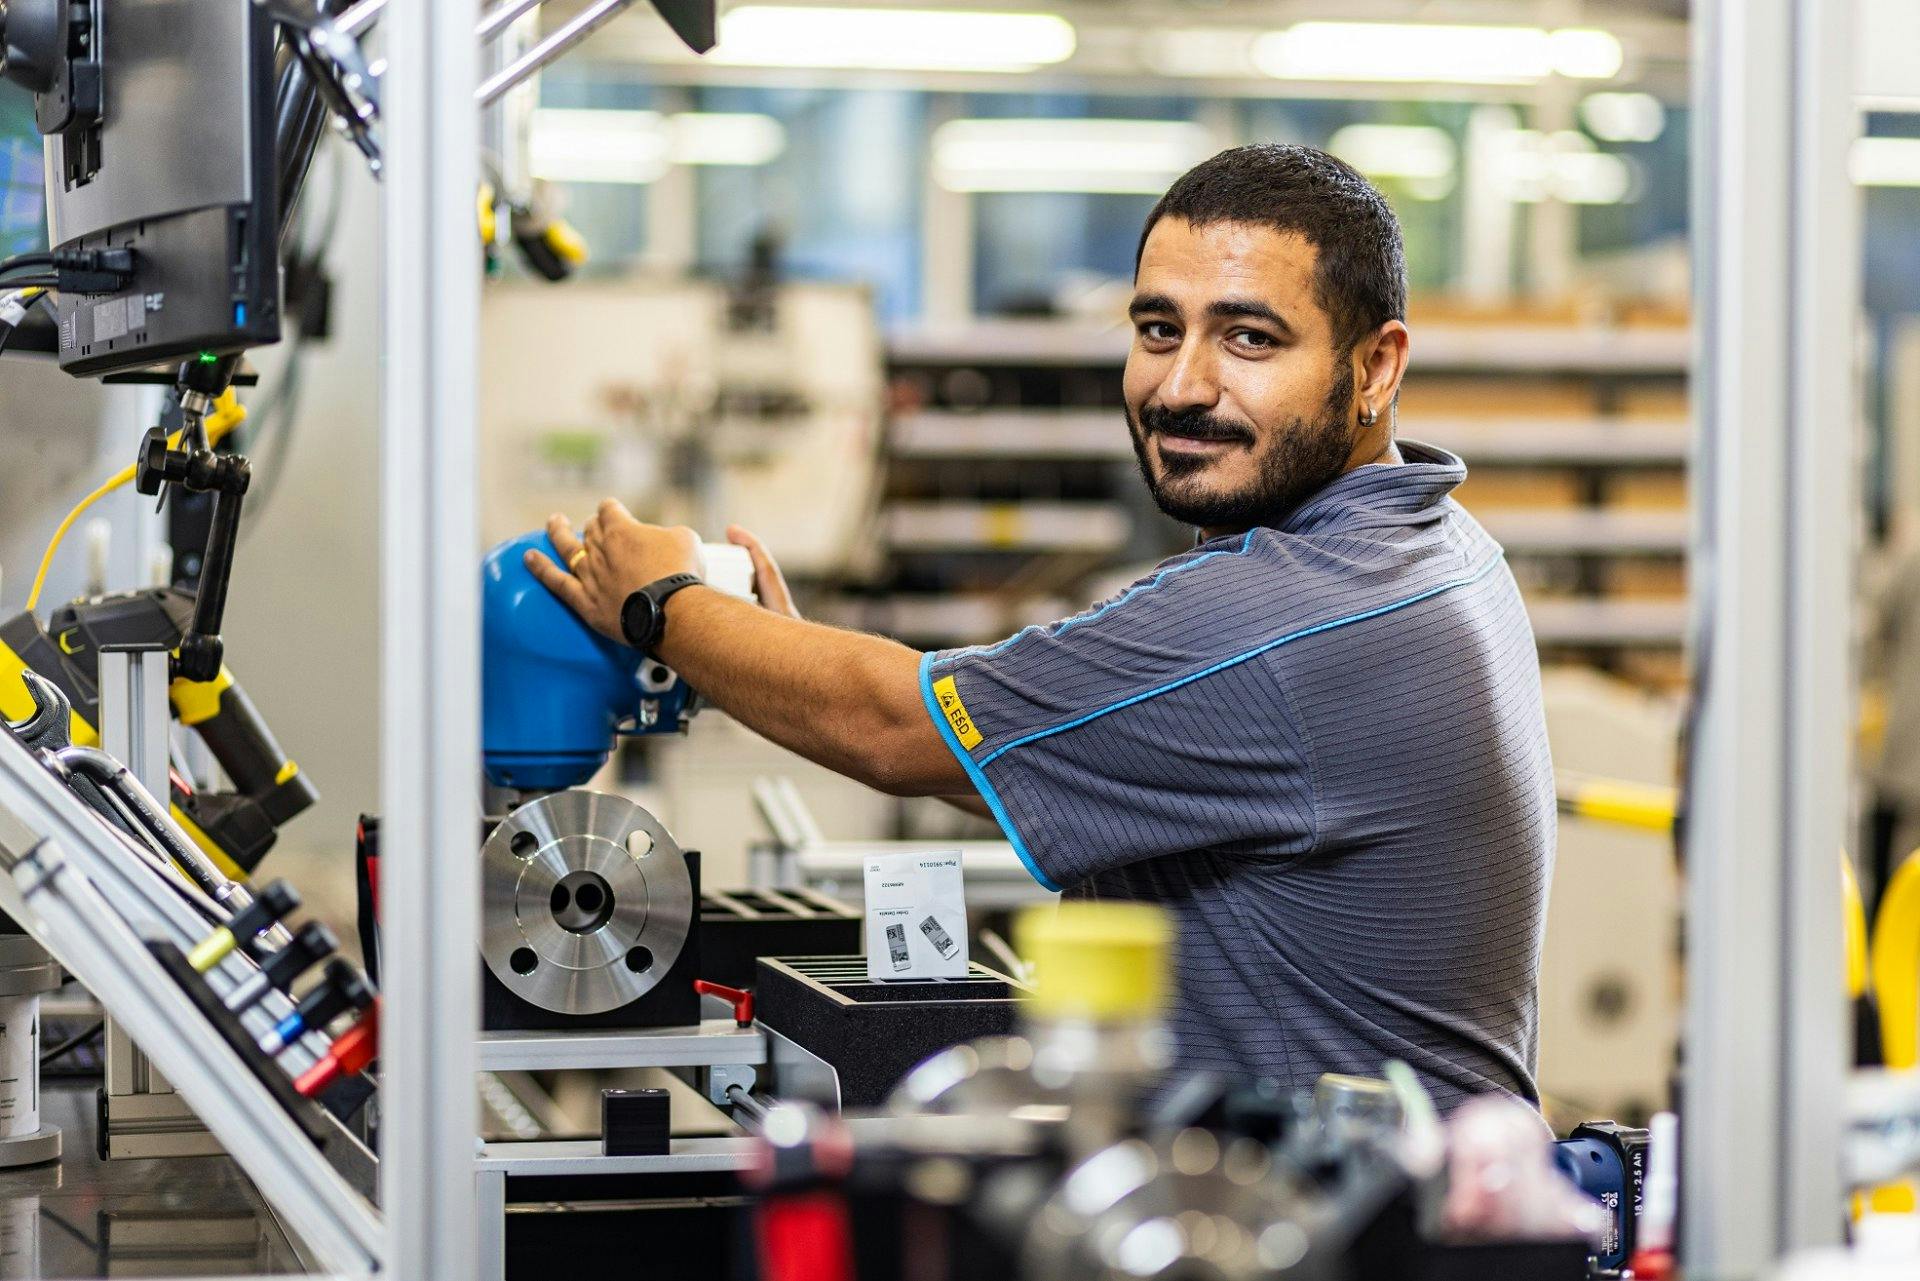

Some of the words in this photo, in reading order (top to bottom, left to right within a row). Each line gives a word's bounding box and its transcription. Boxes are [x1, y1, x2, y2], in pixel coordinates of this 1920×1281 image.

[950, 709, 969, 734] ESD
[1633, 1152, 1642, 1167] Ah
[1634, 1170, 1642, 1185] 2.5
[1634, 1205, 1644, 1217] 18
